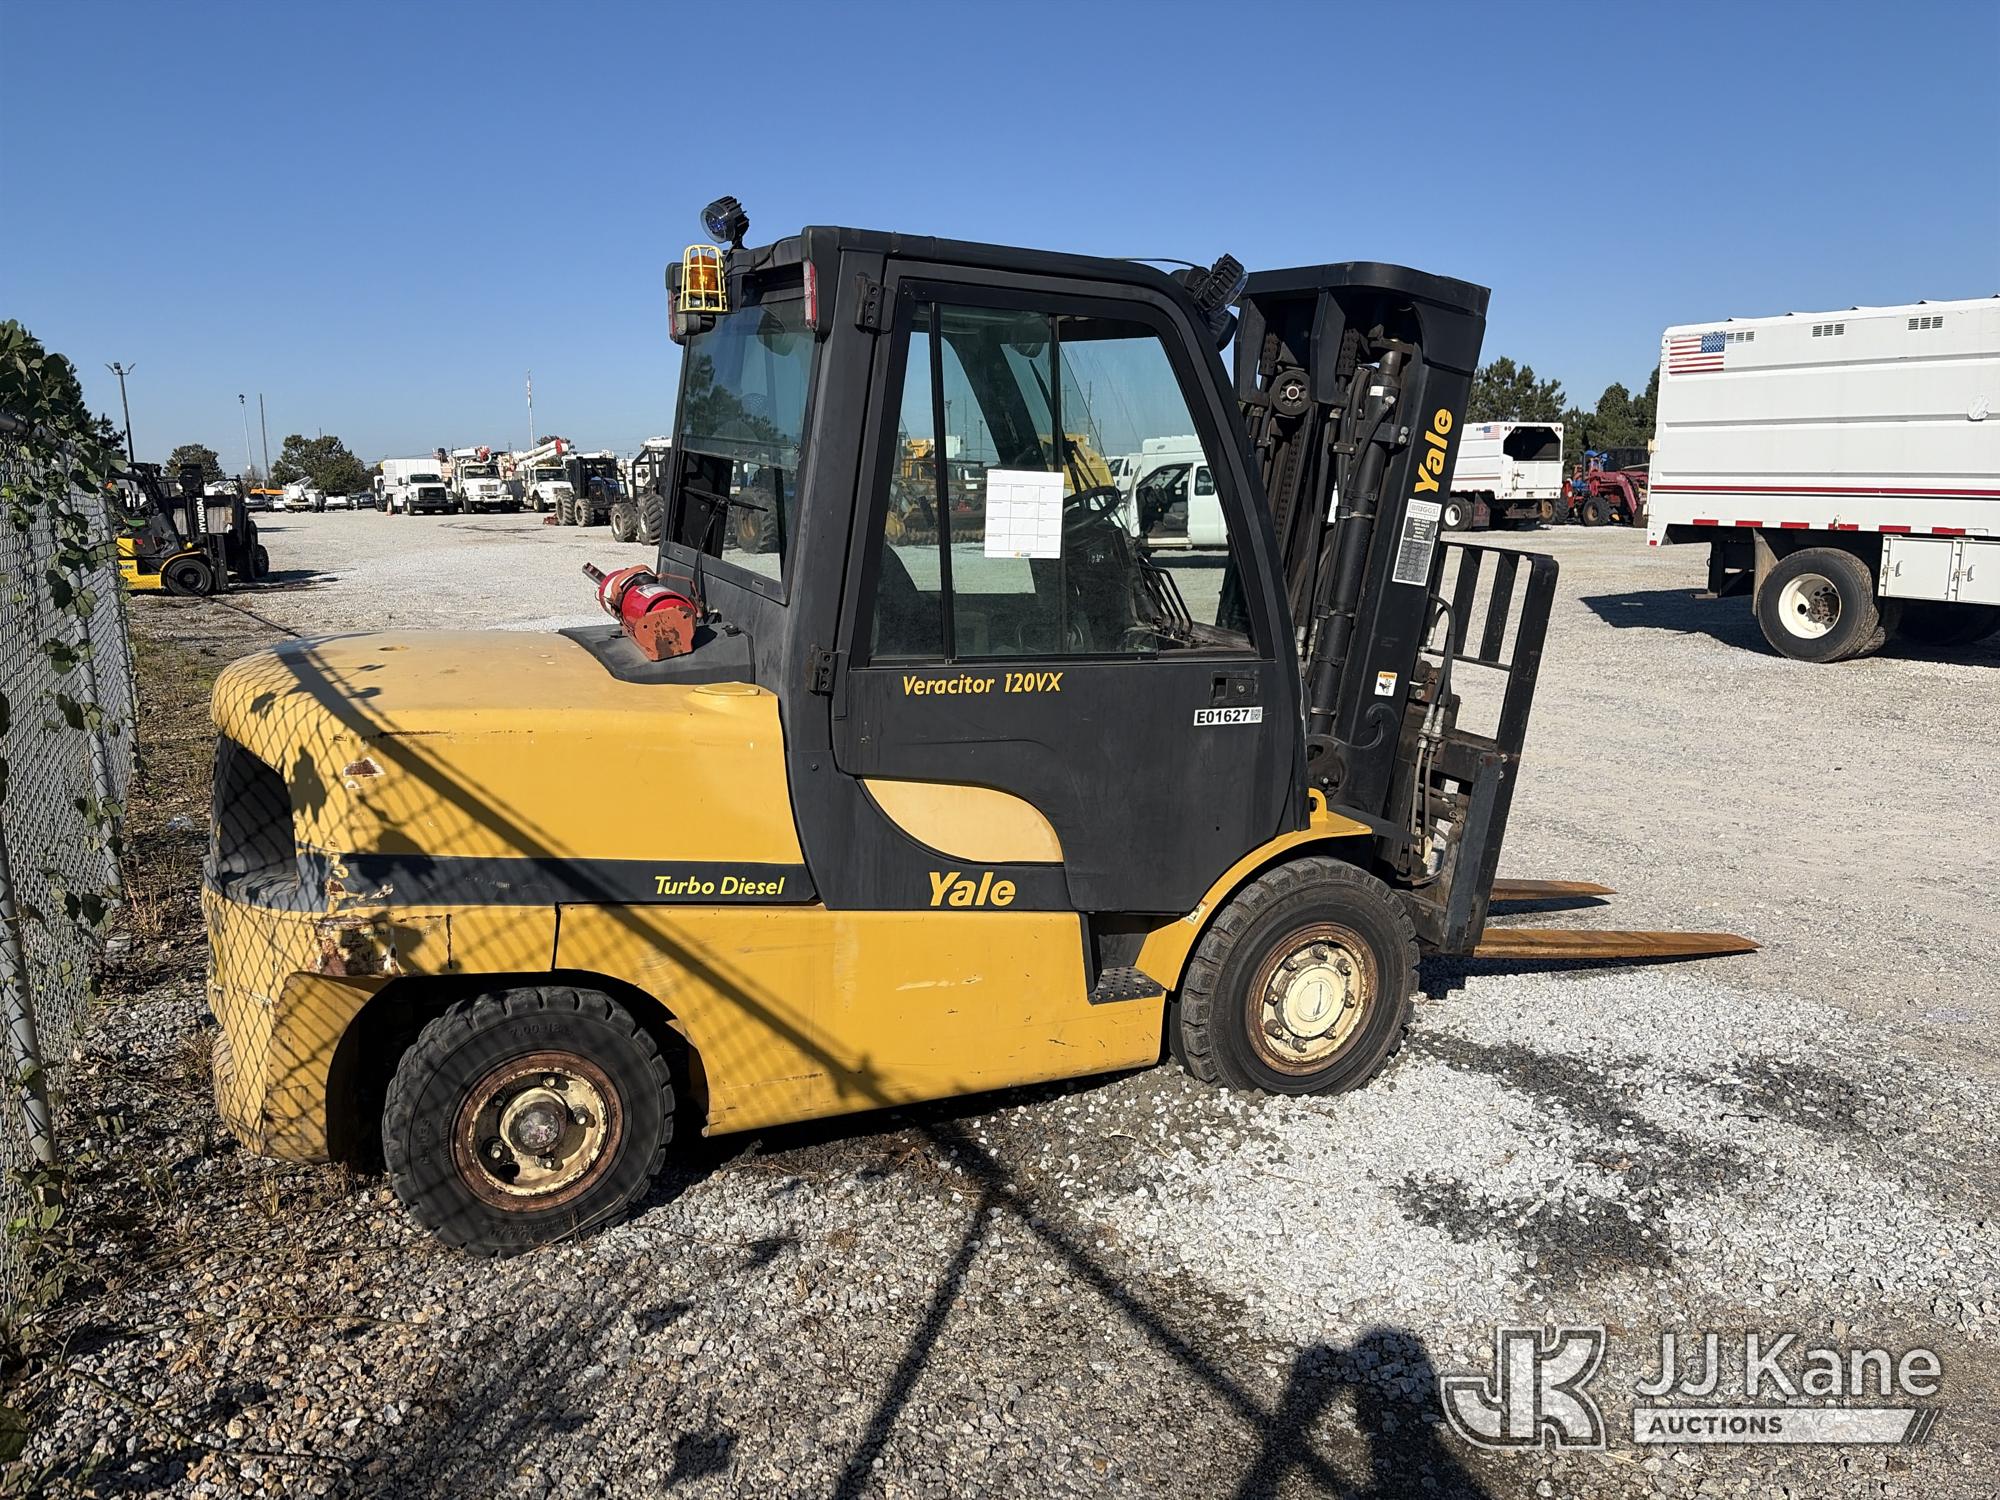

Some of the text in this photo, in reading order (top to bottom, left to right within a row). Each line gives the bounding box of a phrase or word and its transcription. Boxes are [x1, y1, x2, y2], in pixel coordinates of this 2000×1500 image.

[1414, 407, 1453, 493] Yale
[196, 497, 207, 533] HYUNDAI
[903, 672, 1064, 696] Veracitor 120VX
[1196, 709, 1250, 724] E01627
[654, 876, 785, 895] Turbo Diesel
[929, 871, 1016, 907] Yale
